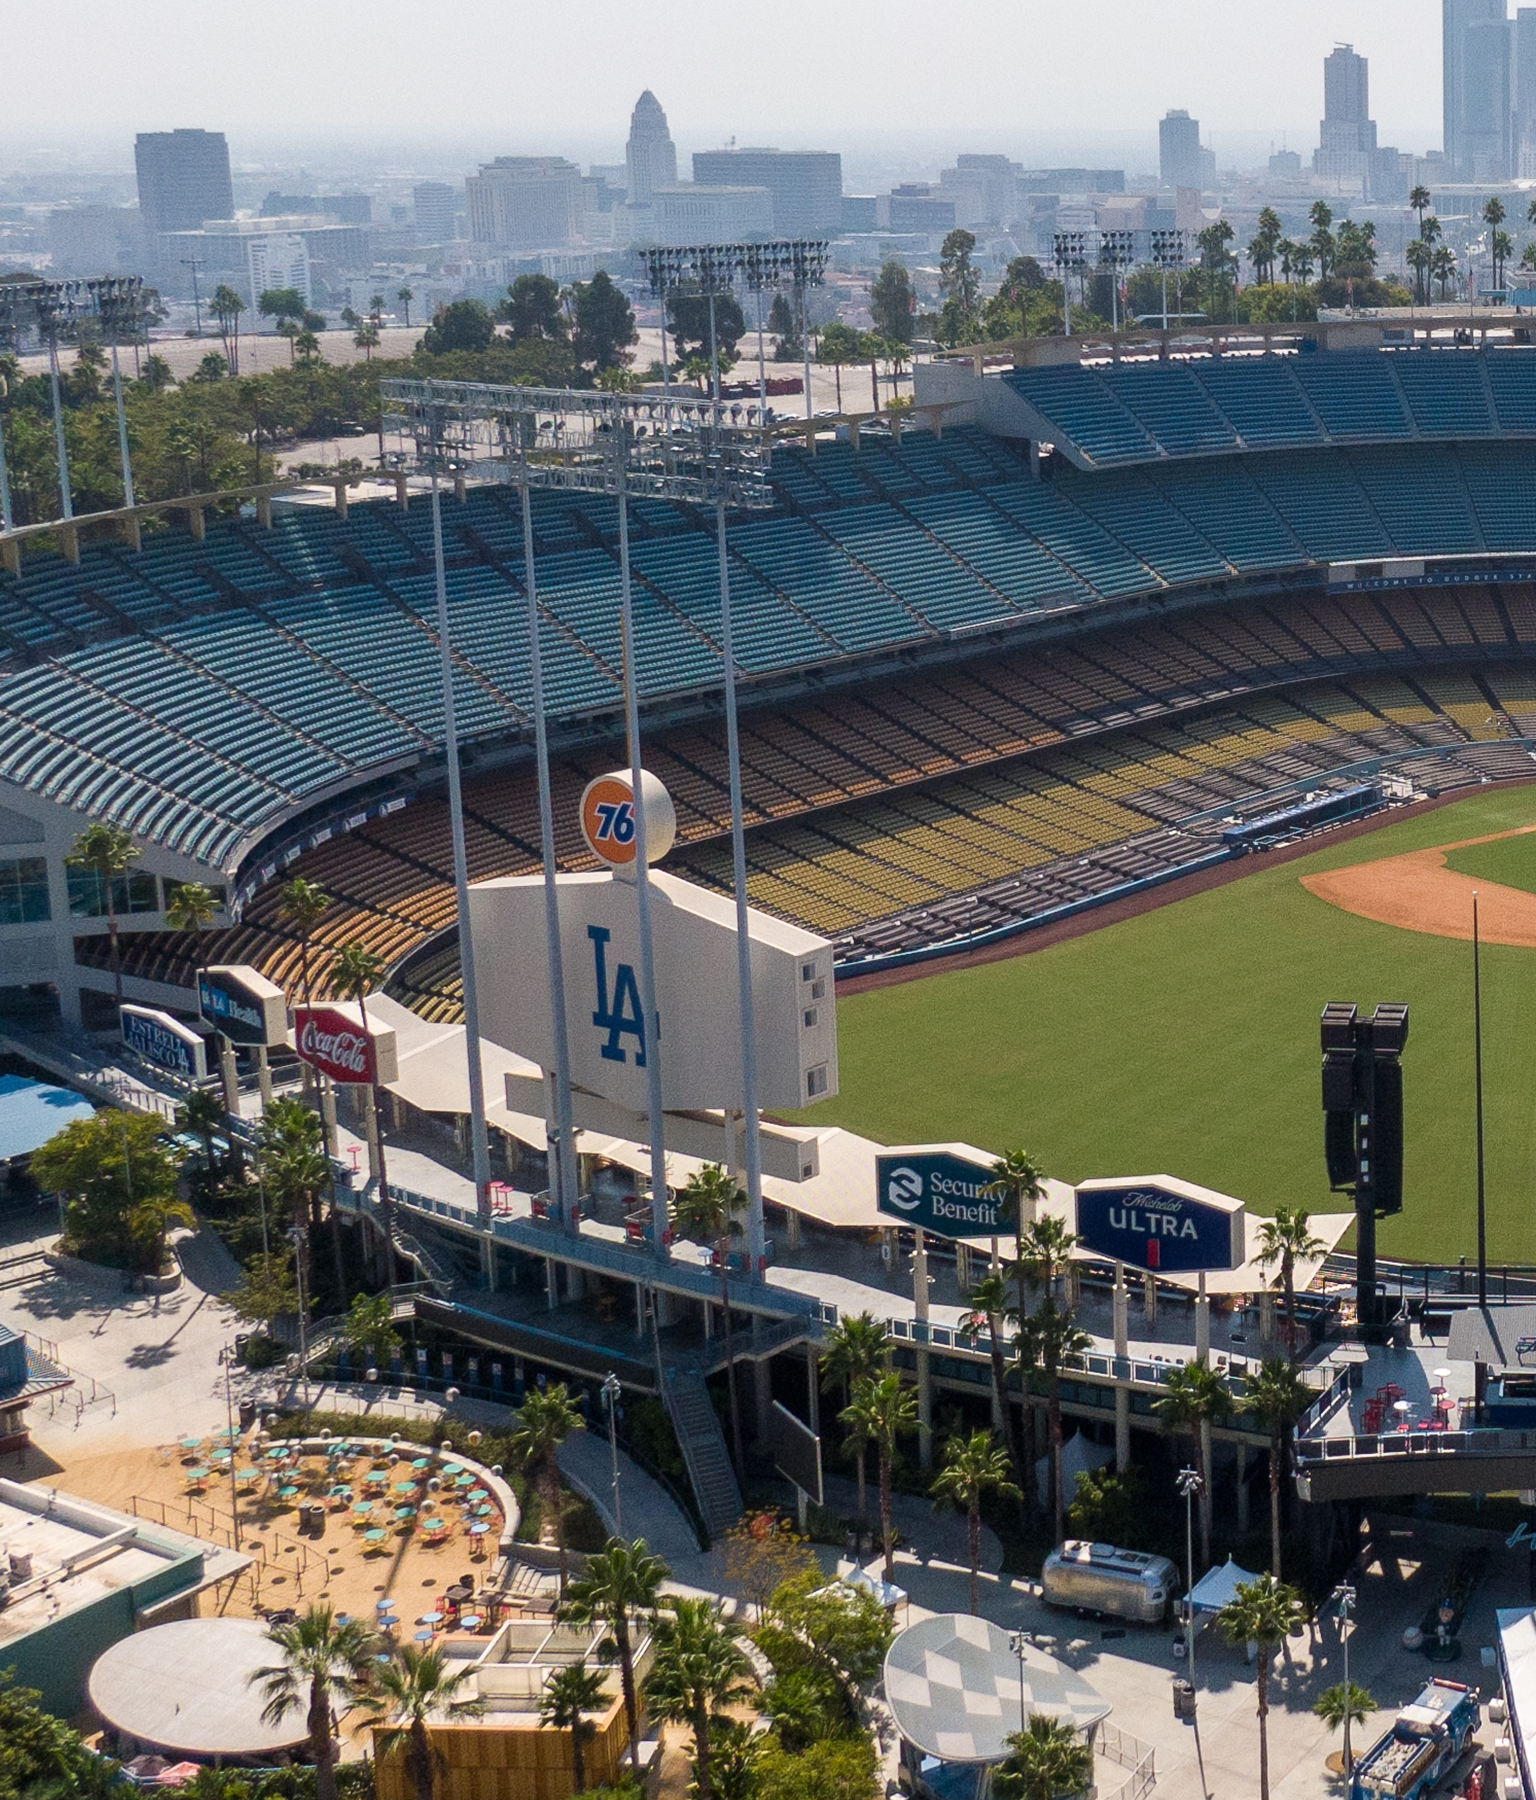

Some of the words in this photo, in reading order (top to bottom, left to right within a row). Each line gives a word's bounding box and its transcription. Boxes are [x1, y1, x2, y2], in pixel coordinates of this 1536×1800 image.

[596, 802, 635, 843] 76
[588, 925, 660, 1067] LA
[931, 1172, 1007, 1207] Security
[1122, 1192, 1184, 1212] Michelob
[931, 1195, 998, 1225] Benefit
[1109, 1207, 1198, 1239] ULTRA
